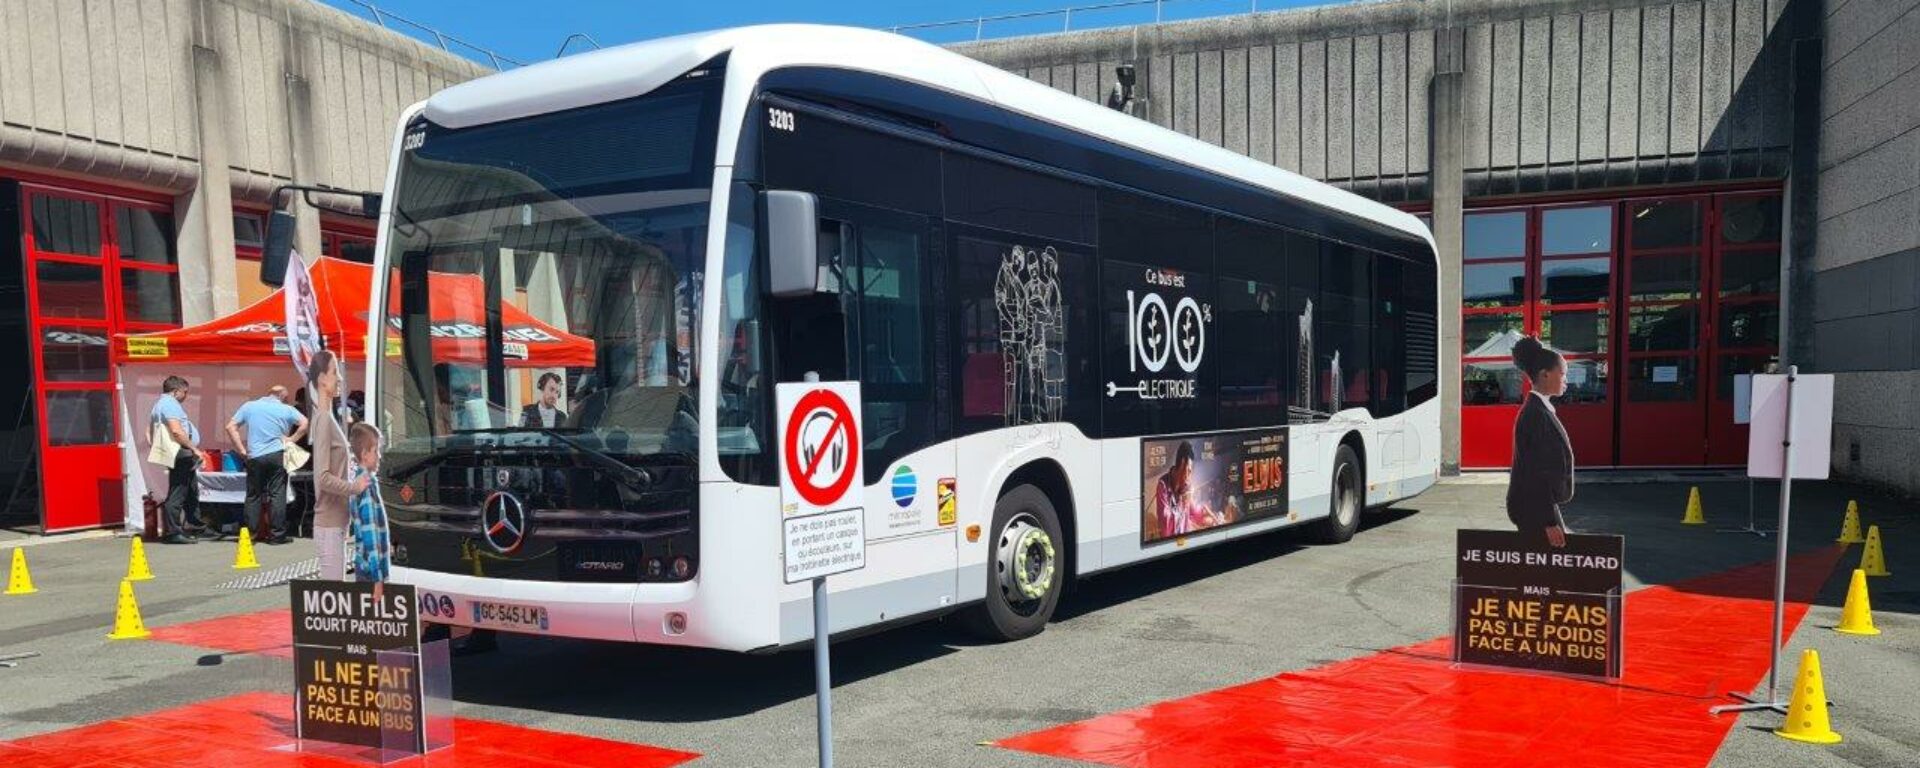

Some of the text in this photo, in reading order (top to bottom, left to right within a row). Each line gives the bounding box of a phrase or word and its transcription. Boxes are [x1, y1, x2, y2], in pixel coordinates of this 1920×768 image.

[769, 107, 795, 132] 3203
[1145, 268, 1185, 288] Ce bus est
[1243, 456, 1282, 493] ELVIS
[824, 519, 836, 529] pas
[1462, 549, 1619, 570] JE SUIS EN RETARD
[1523, 585, 1550, 596] MAIS
[303, 590, 408, 620] MON FILS
[1470, 598, 1607, 626] JE NE FAIS
[304, 616, 408, 637] COURT PARTOUT
[1469, 618, 1606, 644] PAS LE POIDS
[347, 644, 367, 655] MAIS
[1469, 635, 1606, 661] FACE A UN BUS
[314, 660, 411, 689] IL NE FAIT
[307, 684, 413, 712] PAS LE POIDS
[308, 704, 413, 731] FACE A UN BUS
